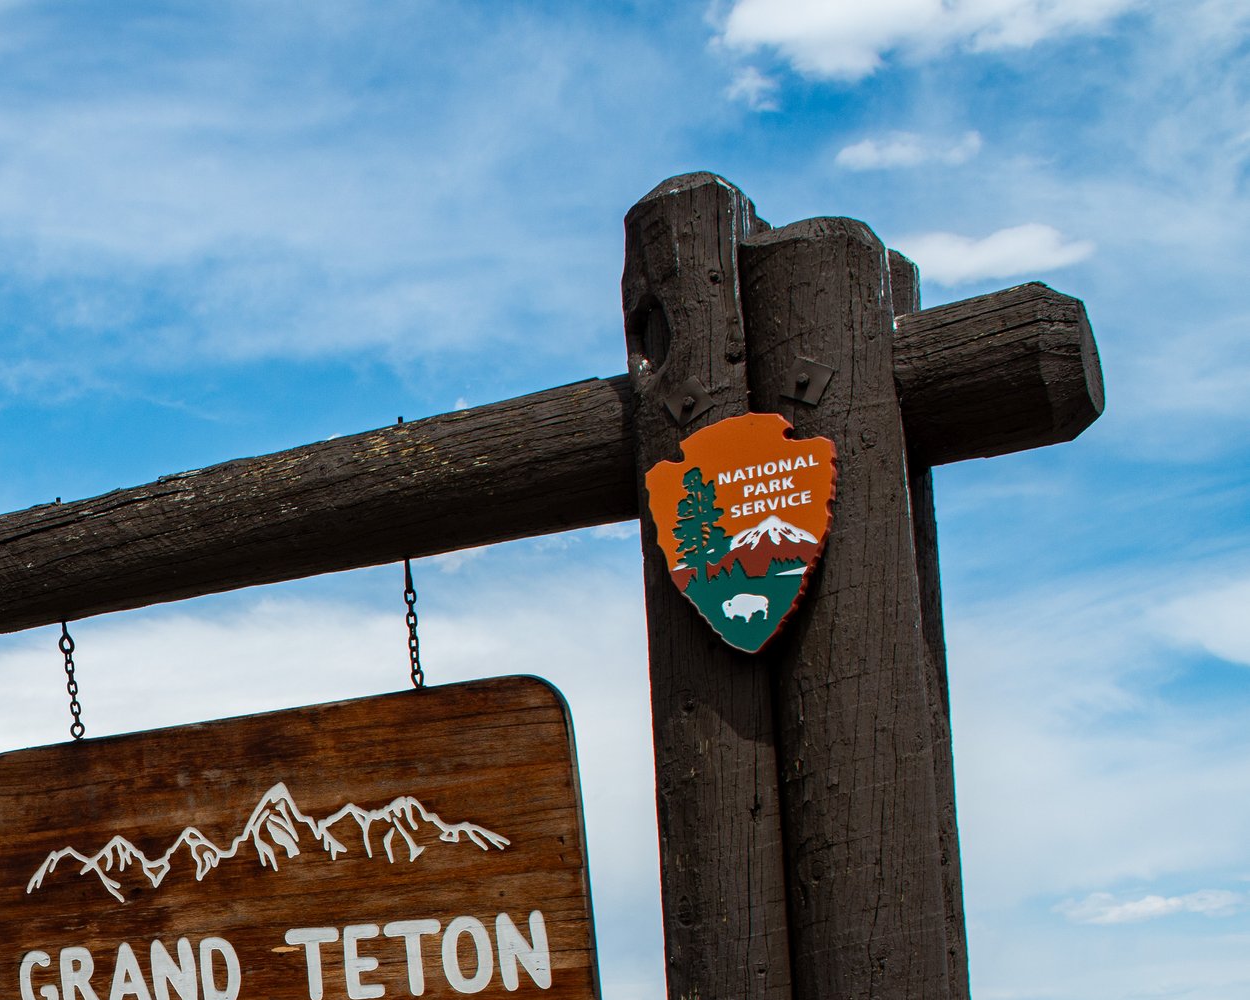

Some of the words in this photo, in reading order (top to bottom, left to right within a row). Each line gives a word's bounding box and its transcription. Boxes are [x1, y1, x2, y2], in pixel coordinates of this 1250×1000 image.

[717, 453, 819, 486] NATIONAL
[743, 475, 795, 498] PARK
[729, 490, 812, 519] SERVICE
